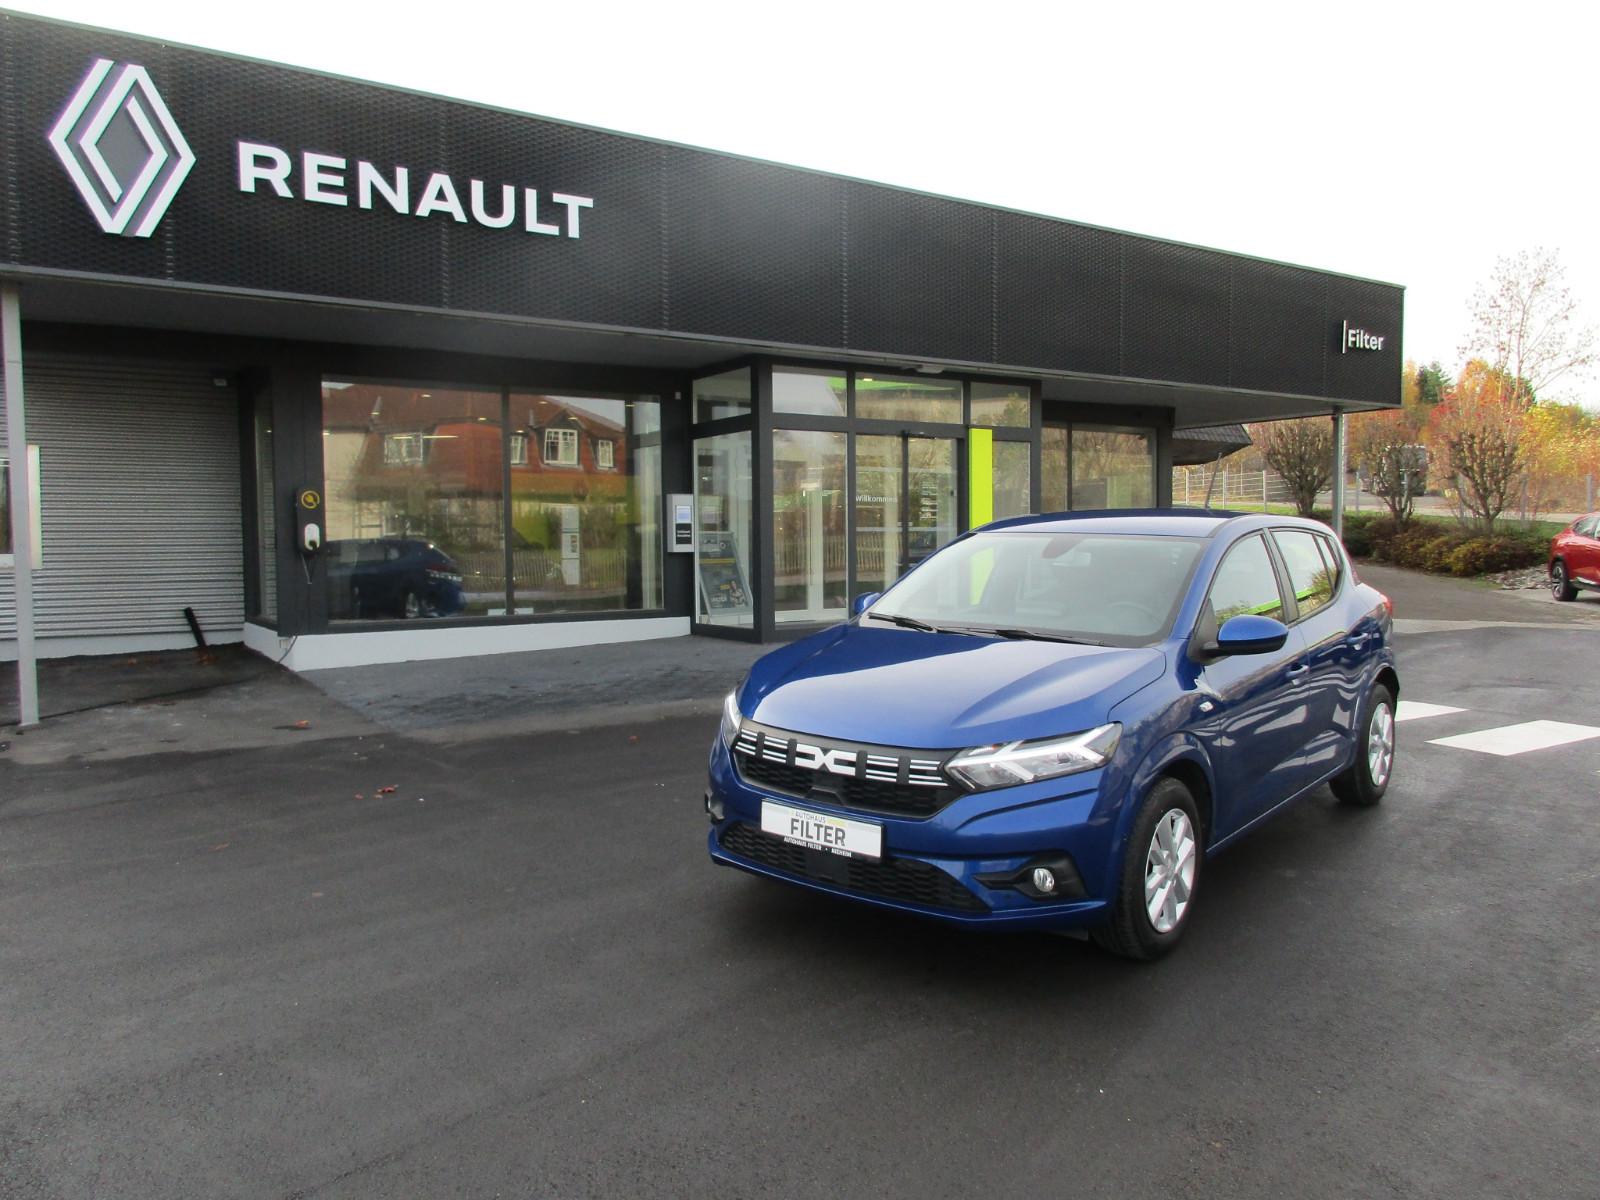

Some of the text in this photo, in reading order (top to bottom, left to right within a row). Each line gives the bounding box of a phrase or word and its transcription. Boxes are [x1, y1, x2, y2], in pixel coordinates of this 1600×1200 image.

[238, 141, 594, 239] RENAULT
[1348, 329, 1384, 350] Filter
[795, 810, 826, 824] AUTOHAUS
[790, 818, 845, 847] FILTER
